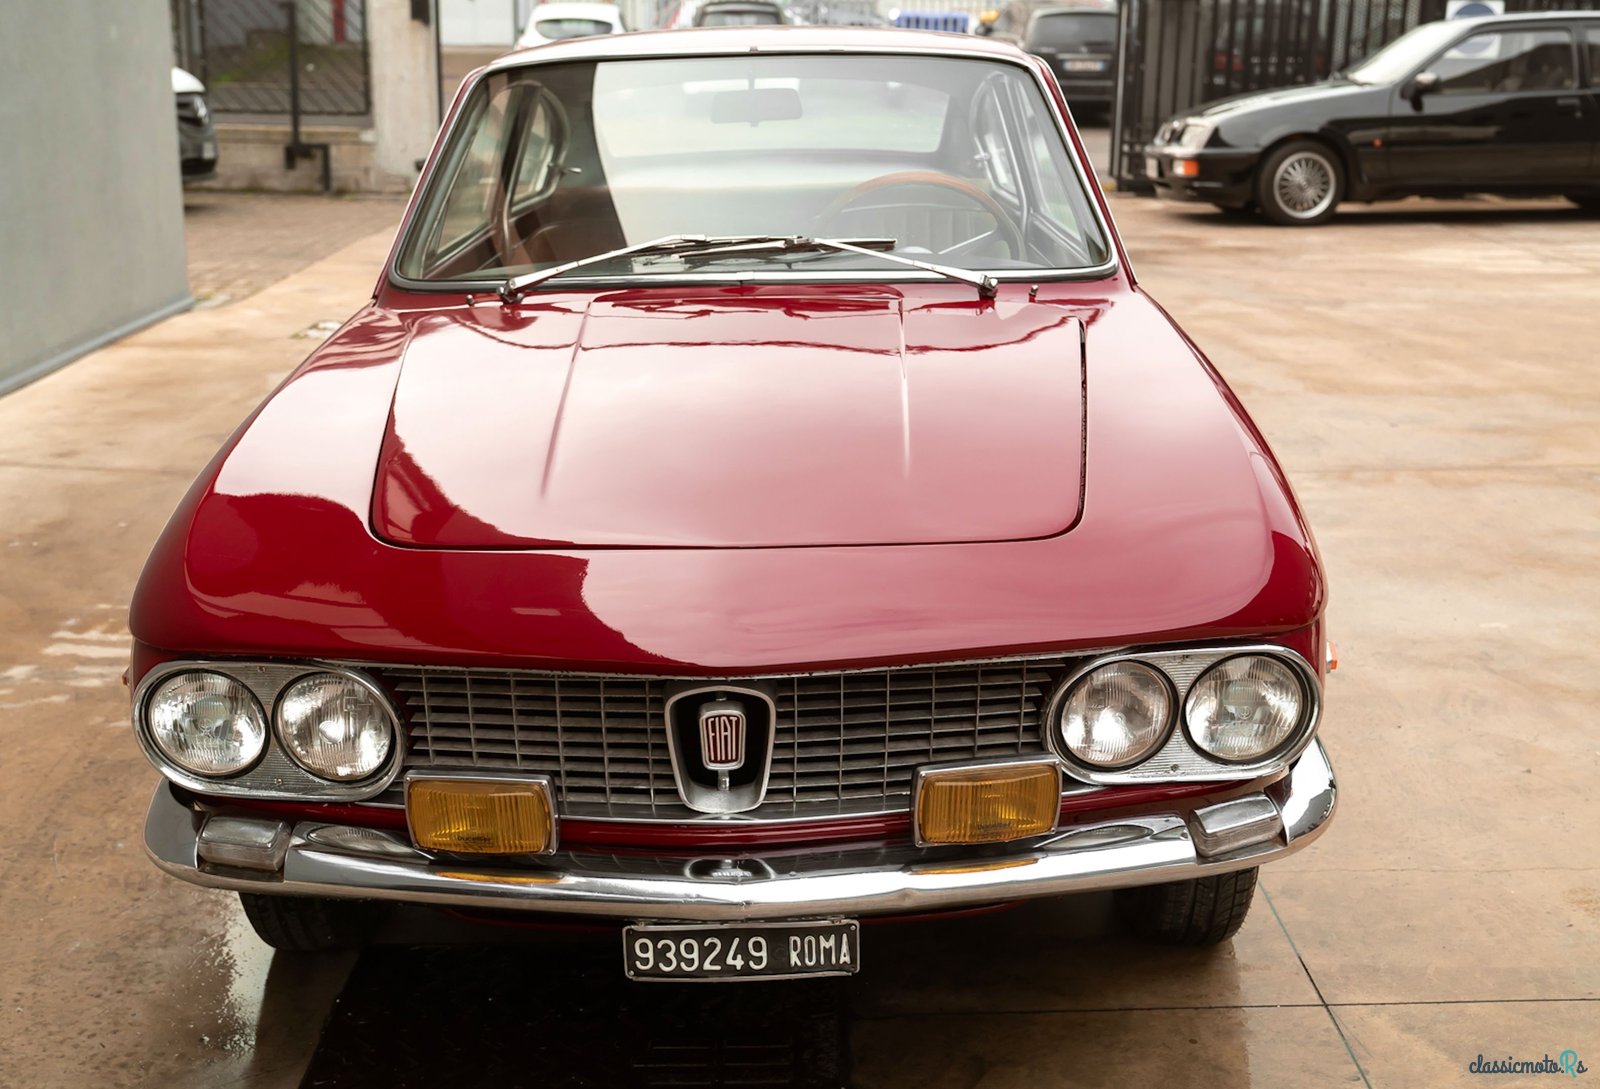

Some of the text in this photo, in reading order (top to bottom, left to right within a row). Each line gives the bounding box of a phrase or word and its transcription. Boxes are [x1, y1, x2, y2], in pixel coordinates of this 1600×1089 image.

[707, 716, 738, 761] FIAT
[633, 932, 851, 973] 939249 ROMA
